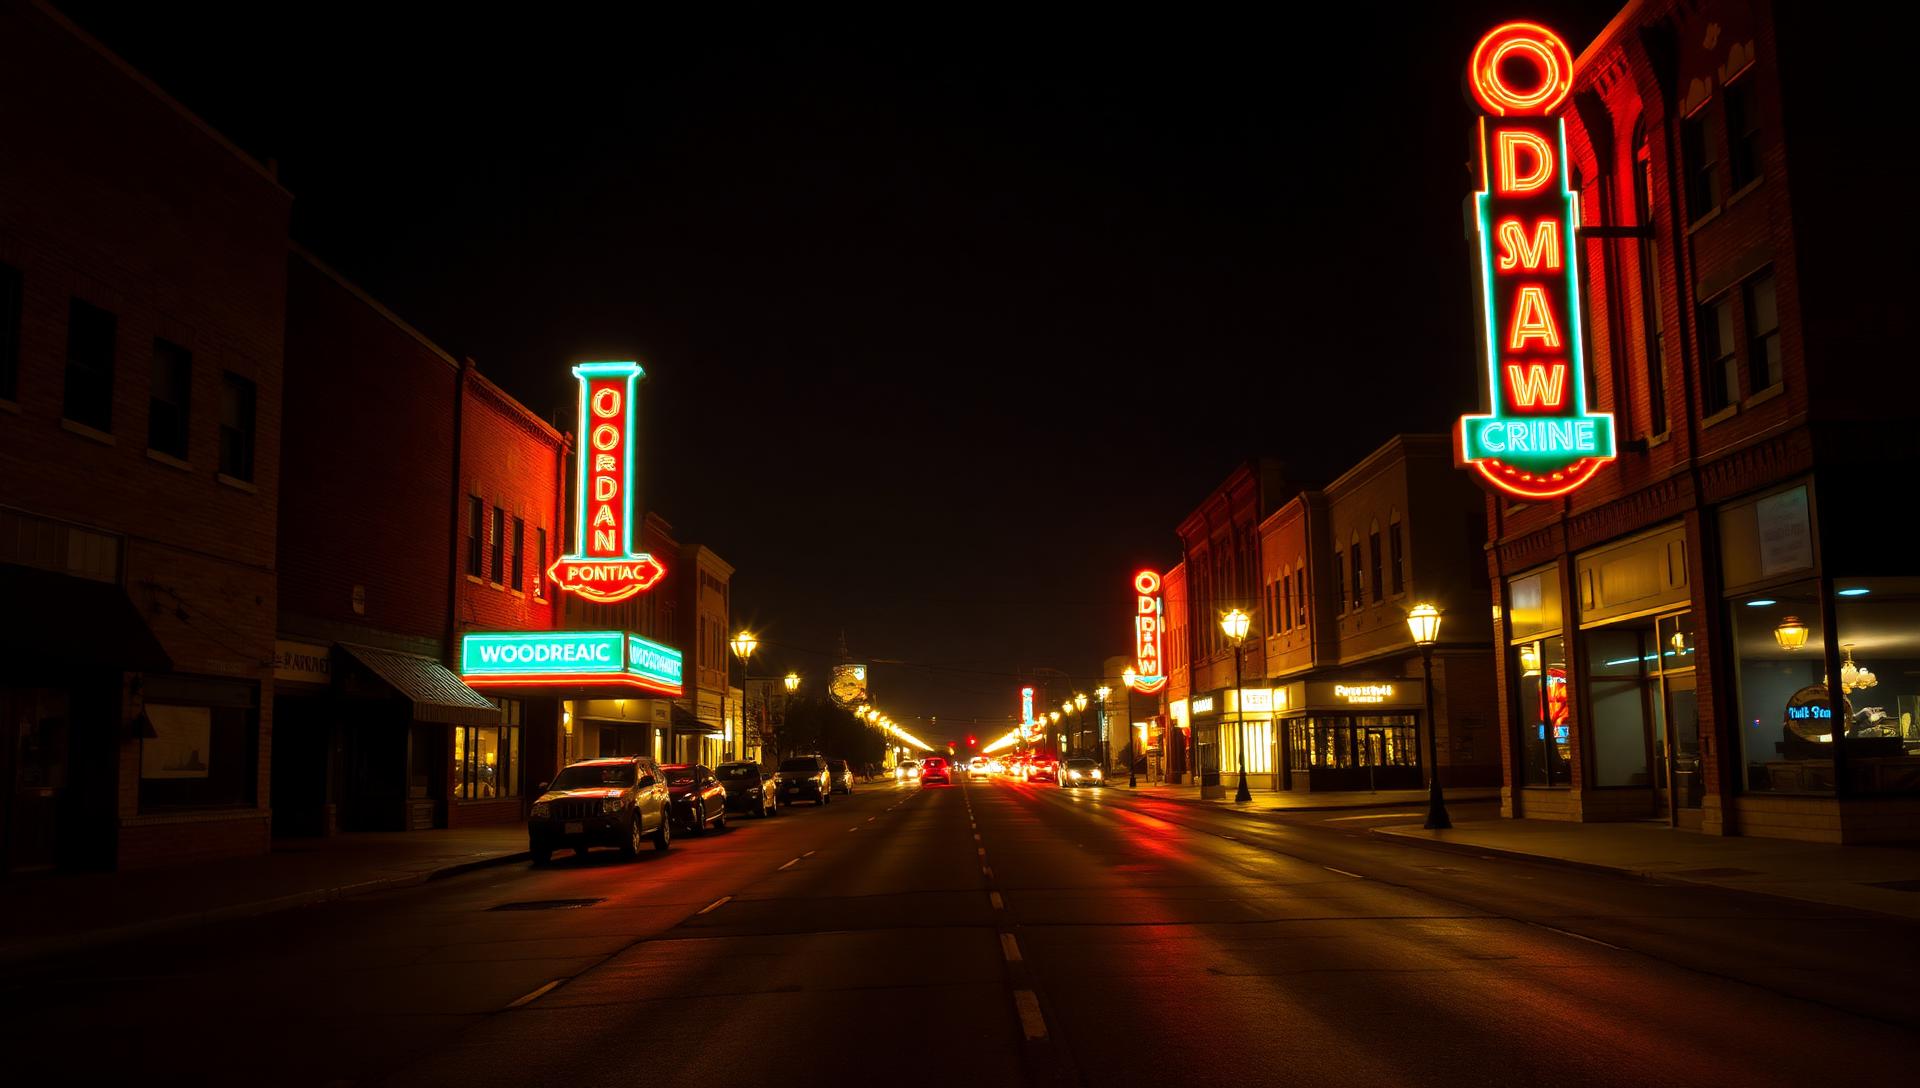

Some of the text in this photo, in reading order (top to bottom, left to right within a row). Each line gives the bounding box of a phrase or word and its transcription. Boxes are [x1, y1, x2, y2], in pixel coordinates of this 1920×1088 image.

[1482, 420, 1595, 452] CRIINE
[567, 564, 645, 582] PONTIAC
[480, 643, 611, 663] WOODREAIC
